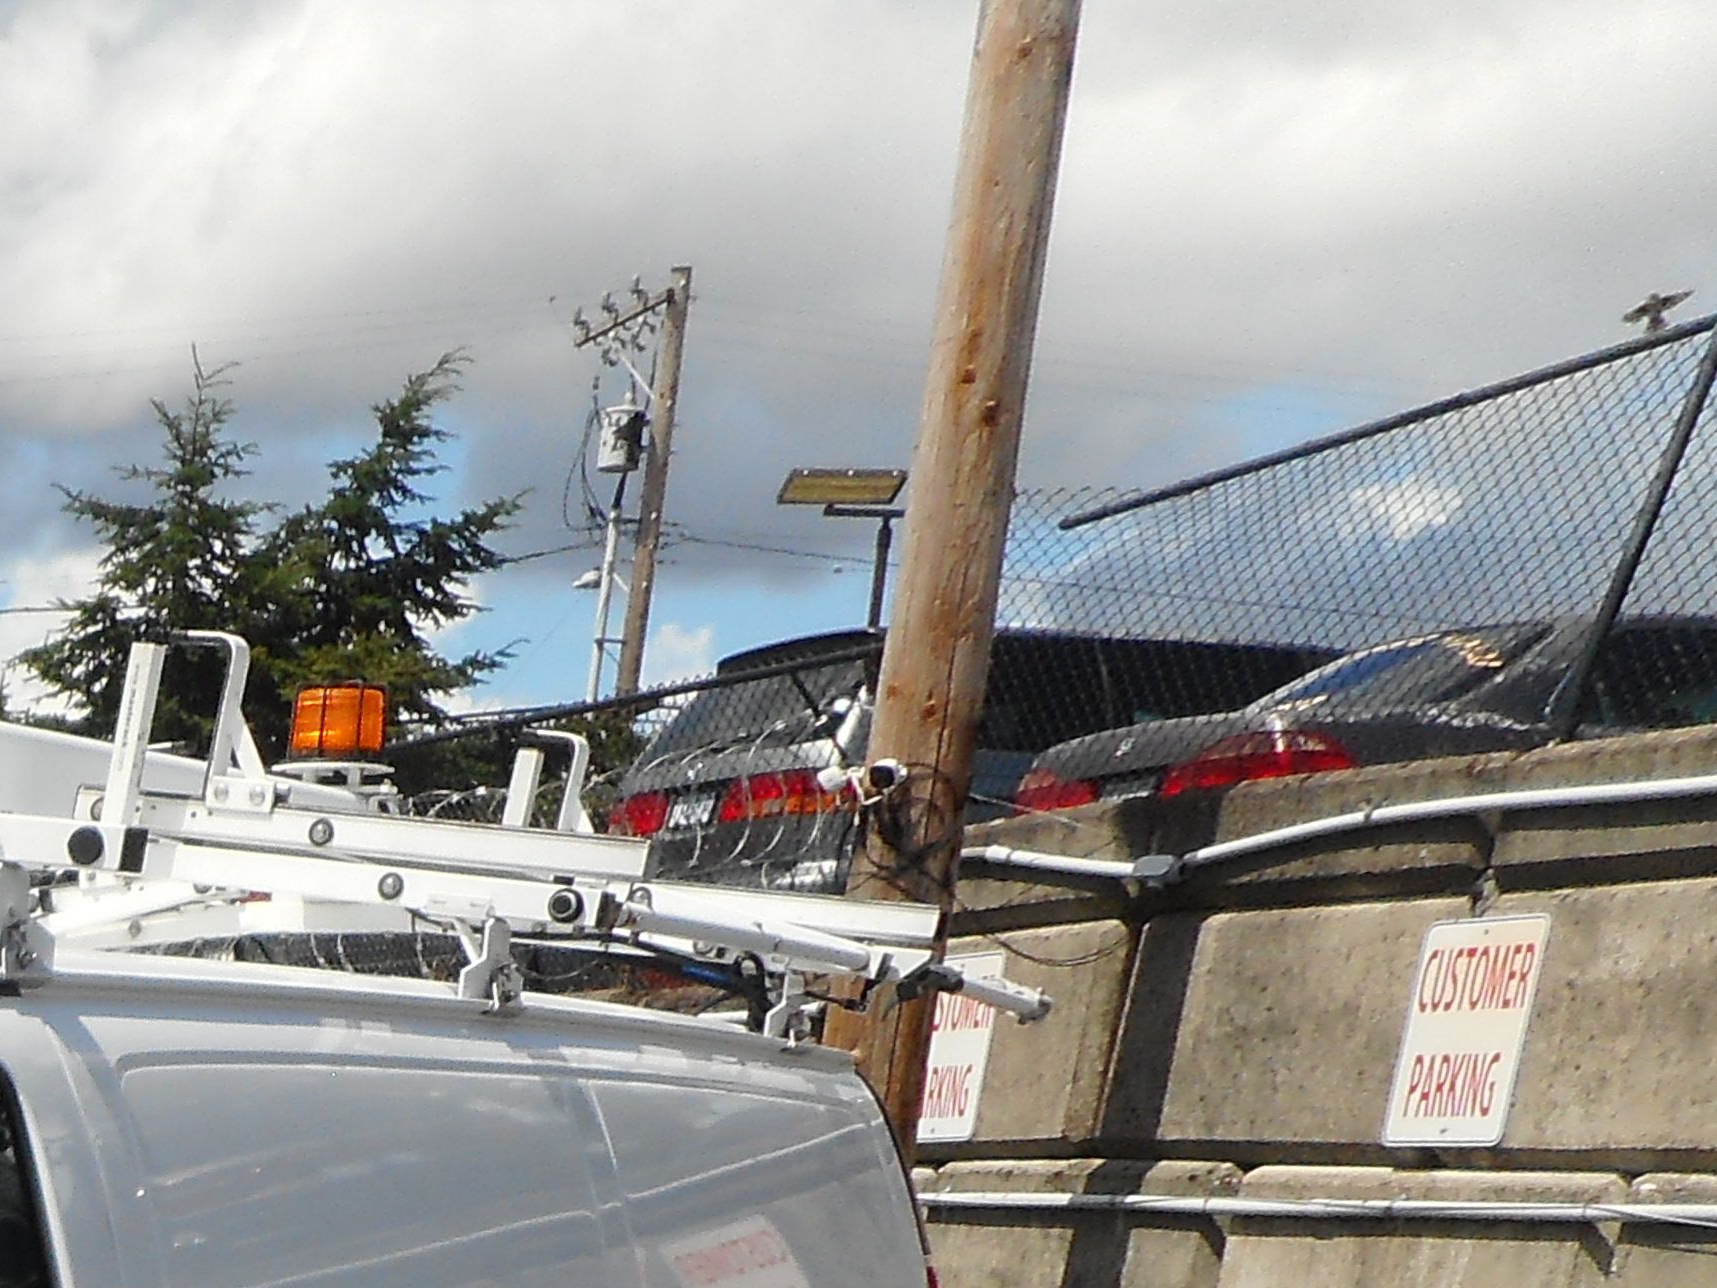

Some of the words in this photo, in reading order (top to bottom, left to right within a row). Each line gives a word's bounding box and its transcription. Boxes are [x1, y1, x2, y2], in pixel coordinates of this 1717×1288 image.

[1418, 944, 1535, 1012] CUSTOMER
[923, 1064, 973, 1118] RKING
[1403, 1052, 1501, 1117] PARKING
